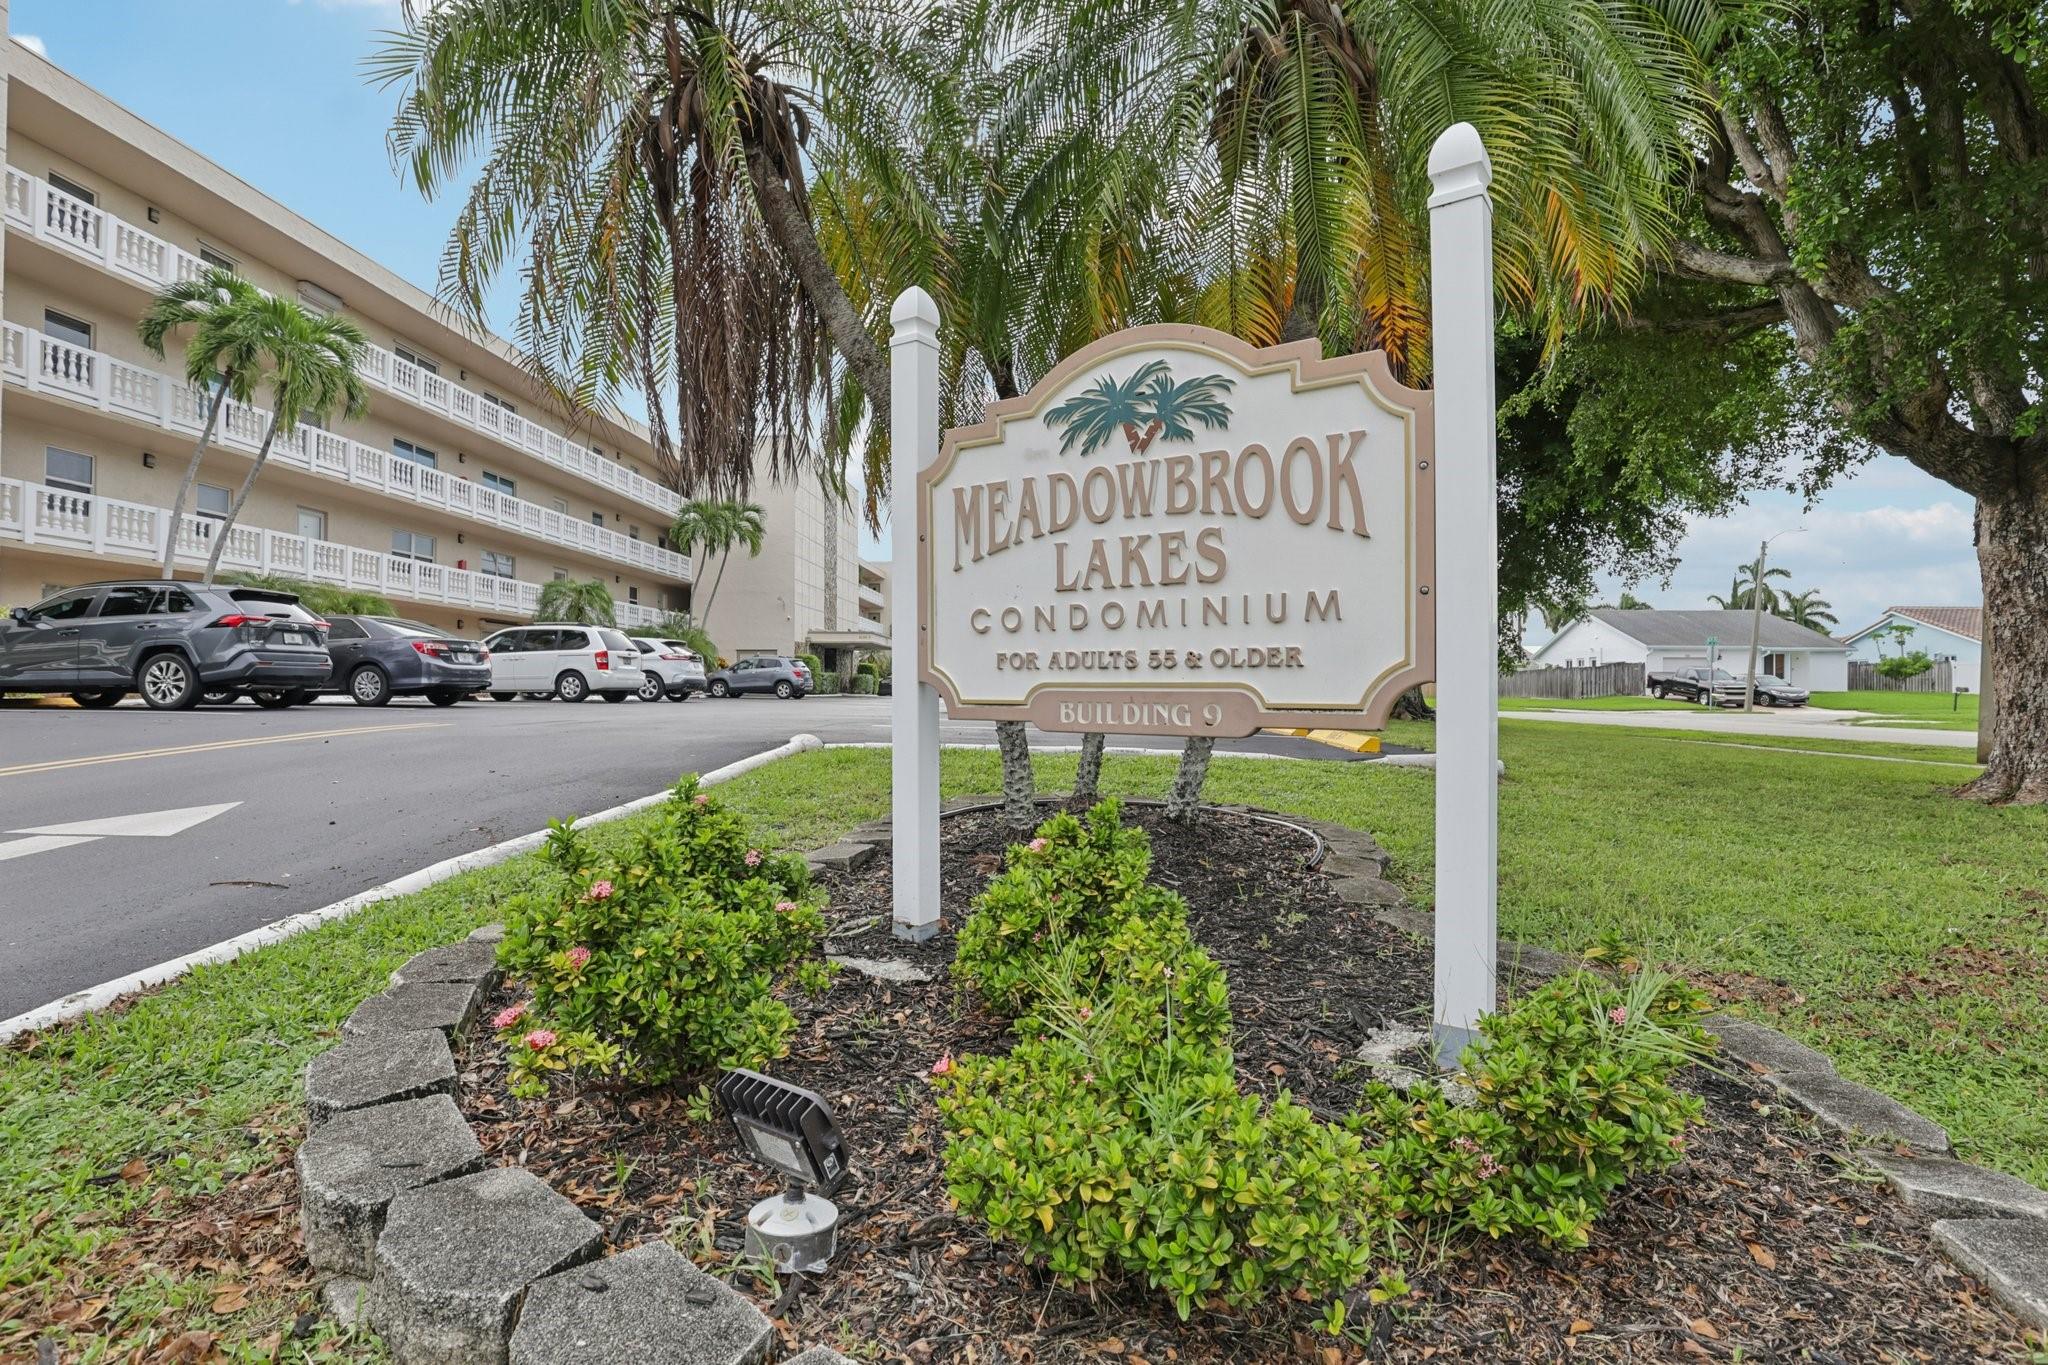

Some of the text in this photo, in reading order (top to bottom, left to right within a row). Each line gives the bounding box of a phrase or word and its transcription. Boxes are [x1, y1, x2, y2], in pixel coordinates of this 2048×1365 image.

[952, 430, 1371, 572] MEADOWBROOK
[1054, 527, 1228, 592] LAKES
[970, 590, 1343, 634] CONDOMINIUM
[996, 646, 1304, 671] FOR ADULTS 55 & OLDER
[1058, 701, 1223, 728] BUILDING 9
